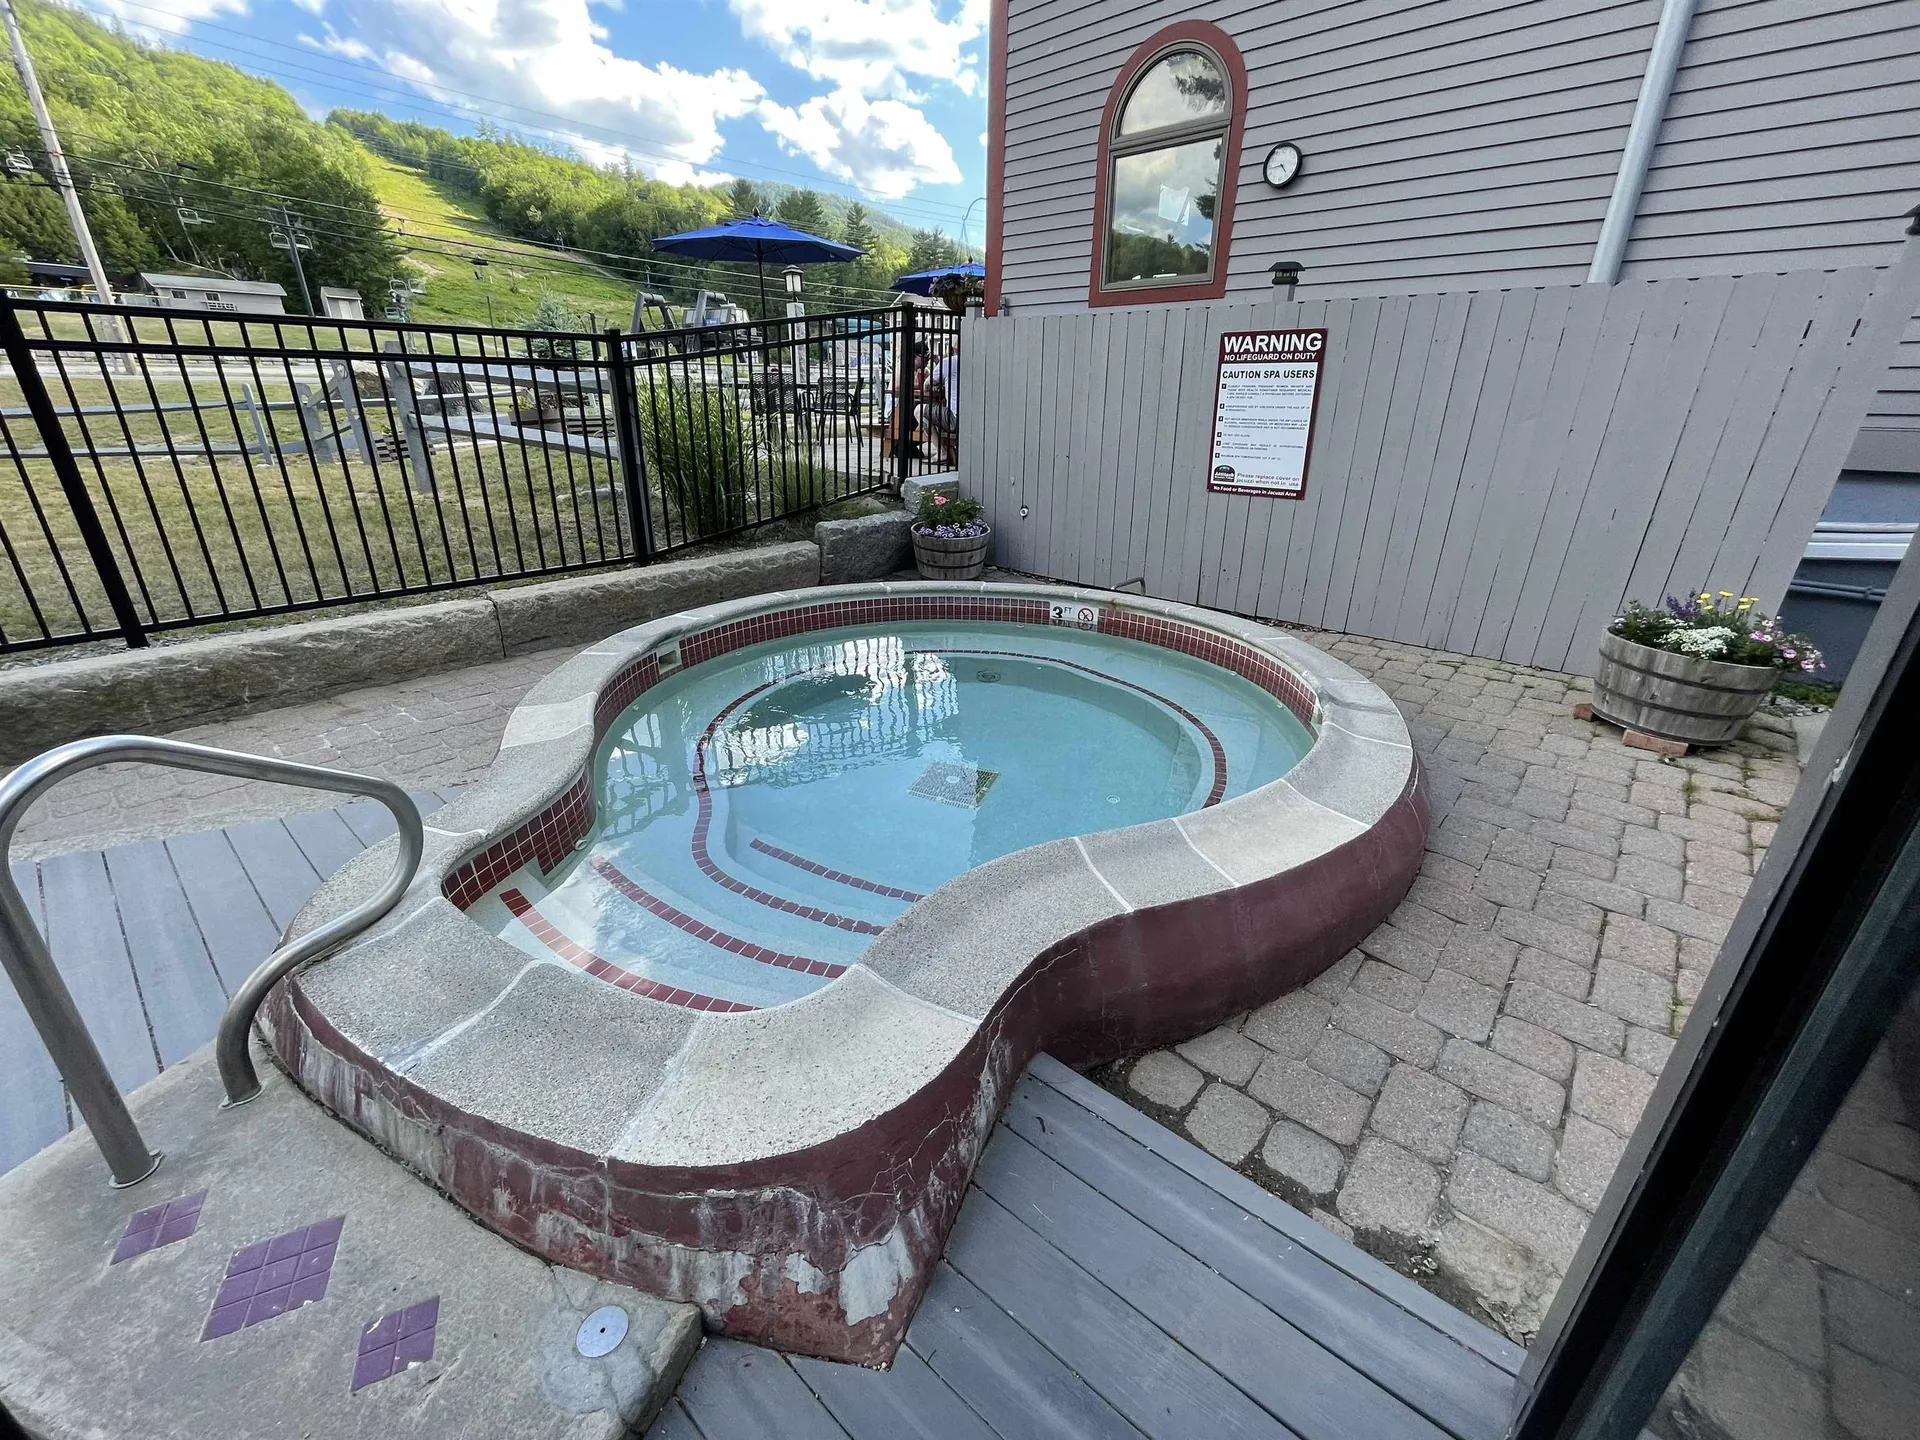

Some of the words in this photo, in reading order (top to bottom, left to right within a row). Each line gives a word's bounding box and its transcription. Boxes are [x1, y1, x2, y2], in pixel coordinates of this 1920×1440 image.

[1224, 333, 1322, 352] WARNING
[1236, 353, 1280, 361] LIFEGUARD
[1280, 352, 1293, 360] ON
[1294, 352, 1317, 360] DUTY
[1222, 370, 1261, 379] CAUTION
[1263, 370, 1281, 379] SPA
[1283, 370, 1315, 379] USERS
[1255, 473, 1275, 481] replace
[1052, 606, 1063, 618] 3
